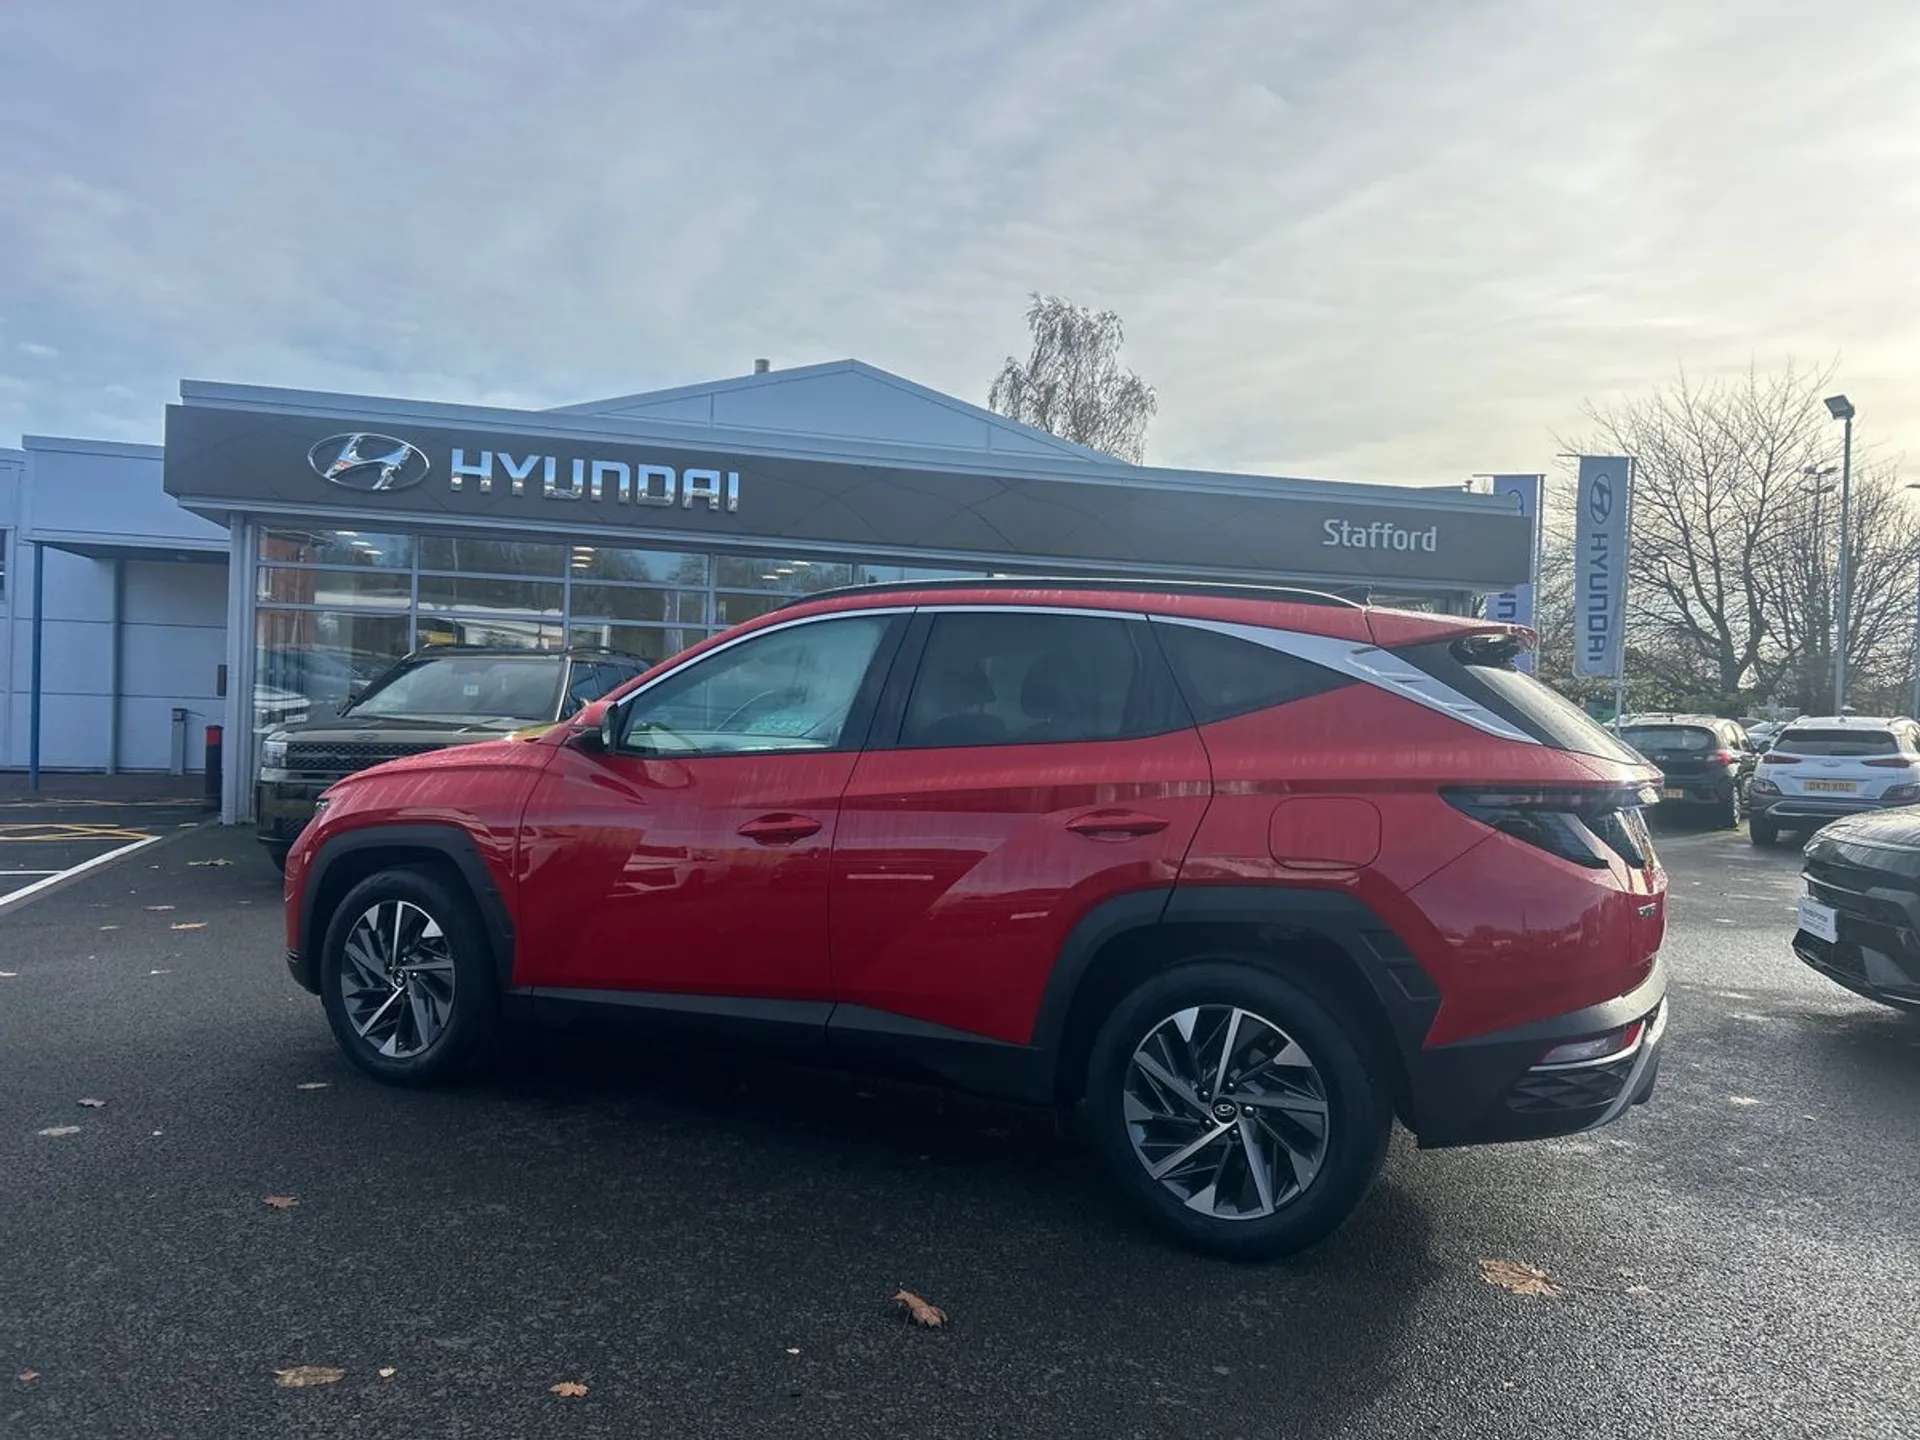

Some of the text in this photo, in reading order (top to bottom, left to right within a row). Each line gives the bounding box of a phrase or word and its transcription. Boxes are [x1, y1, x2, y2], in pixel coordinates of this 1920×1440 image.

[451, 448, 739, 513] HYUNDAI
[1323, 519, 1437, 551] Stafford
[1588, 533, 1609, 661] HYUNDAI
